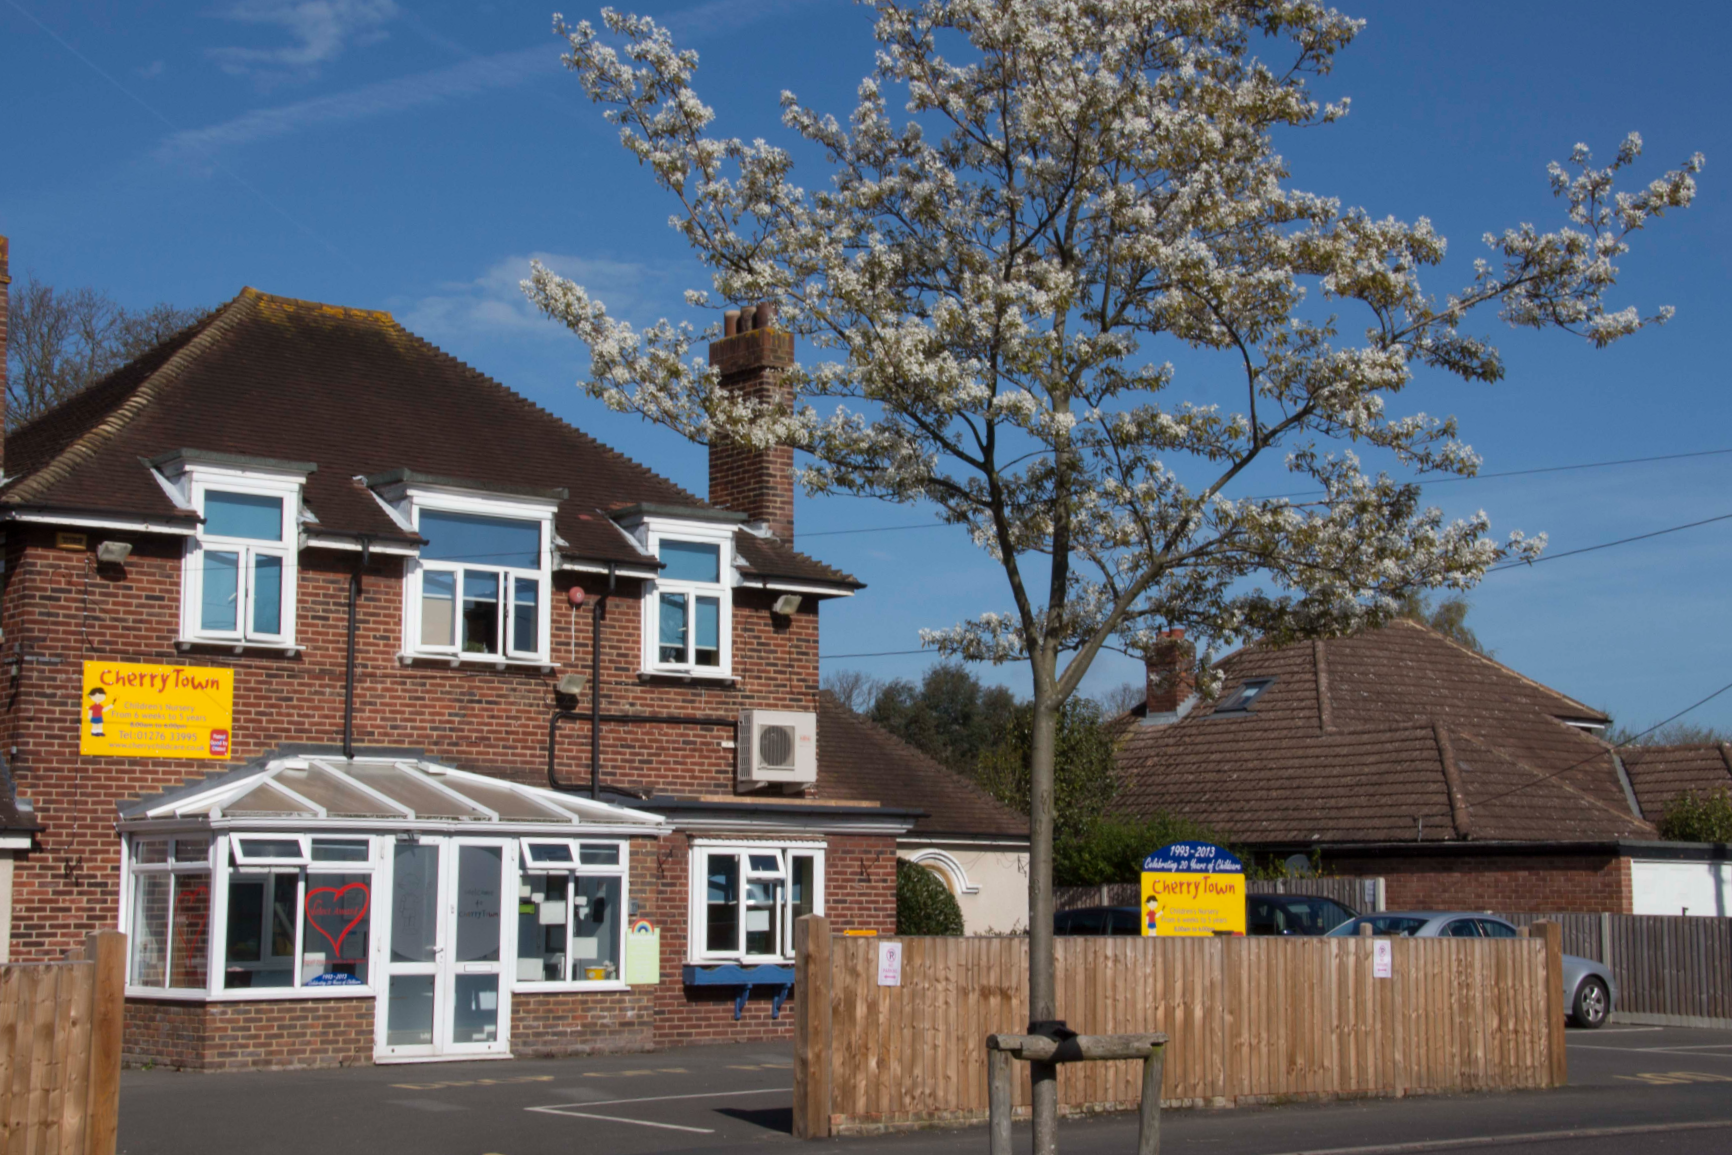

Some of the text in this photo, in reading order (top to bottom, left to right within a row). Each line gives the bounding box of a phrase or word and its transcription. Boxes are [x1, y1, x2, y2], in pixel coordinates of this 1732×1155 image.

[124, 701, 195, 713] Children's Nursery
[111, 710, 131, 718] From
[142, 712, 165, 720] weeks
[168, 713, 176, 721] to
[179, 713, 184, 721] 5
[186, 715, 206, 723] years
[170, 732, 197, 742] 33995
[1144, 857, 1178, 873] Celebrating
[1179, 860, 1189, 870] 20
[1190, 858, 1207, 871] Years
[1207, 859, 1215, 873] of
[1170, 907, 1219, 916] Children's Nursery
